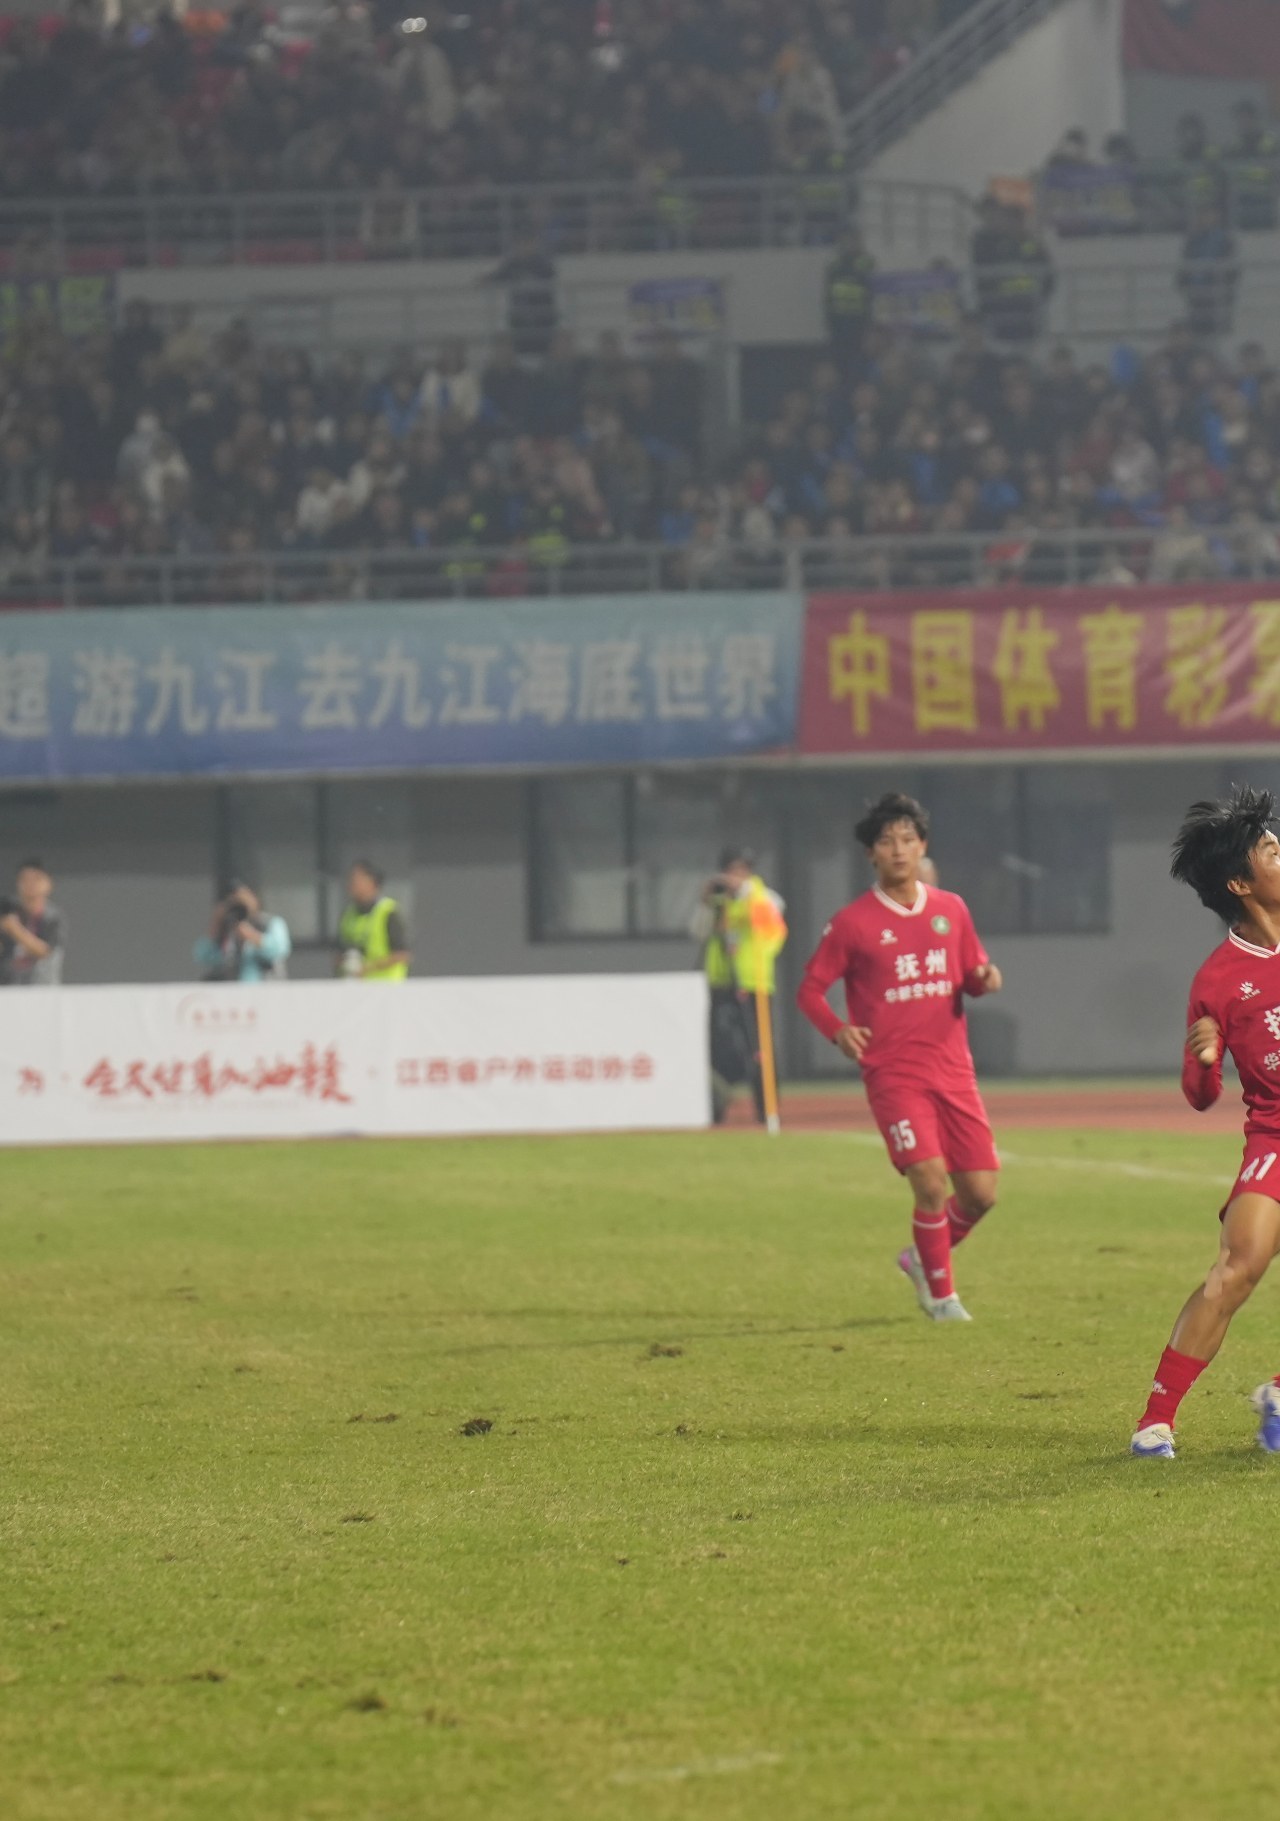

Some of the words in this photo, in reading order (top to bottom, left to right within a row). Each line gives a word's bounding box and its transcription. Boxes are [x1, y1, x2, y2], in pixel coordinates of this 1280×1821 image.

[71, 646, 278, 736] 游九江
[299, 633, 776, 730] 去九江海底世界
[894, 947, 947, 981] 抚州
[396, 1052, 655, 1087] 江西省户外运动协会
